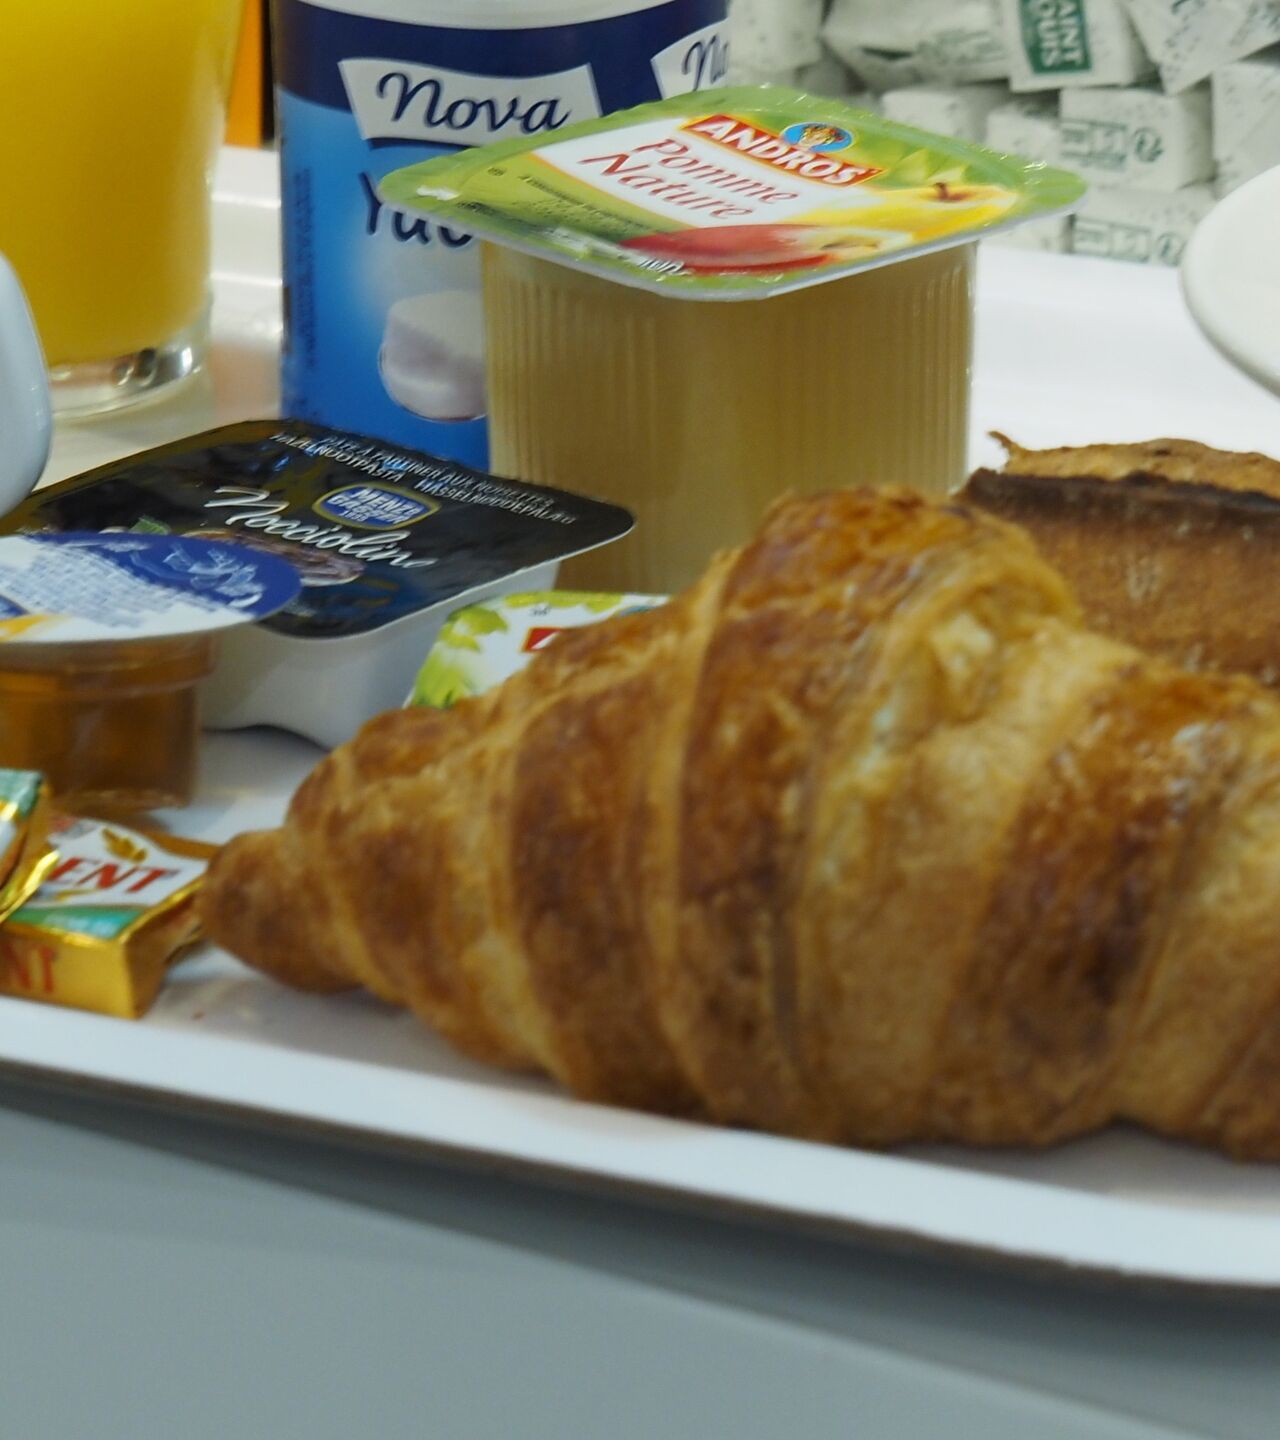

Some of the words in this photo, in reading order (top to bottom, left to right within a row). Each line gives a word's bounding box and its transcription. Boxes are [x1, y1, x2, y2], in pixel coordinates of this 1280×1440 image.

[376, 72, 572, 134] Nova
[632, 138, 800, 205] Pomme
[694, 119, 867, 185] ANDROS
[578, 153, 754, 220] Nature
[46, 856, 170, 894] ENT
